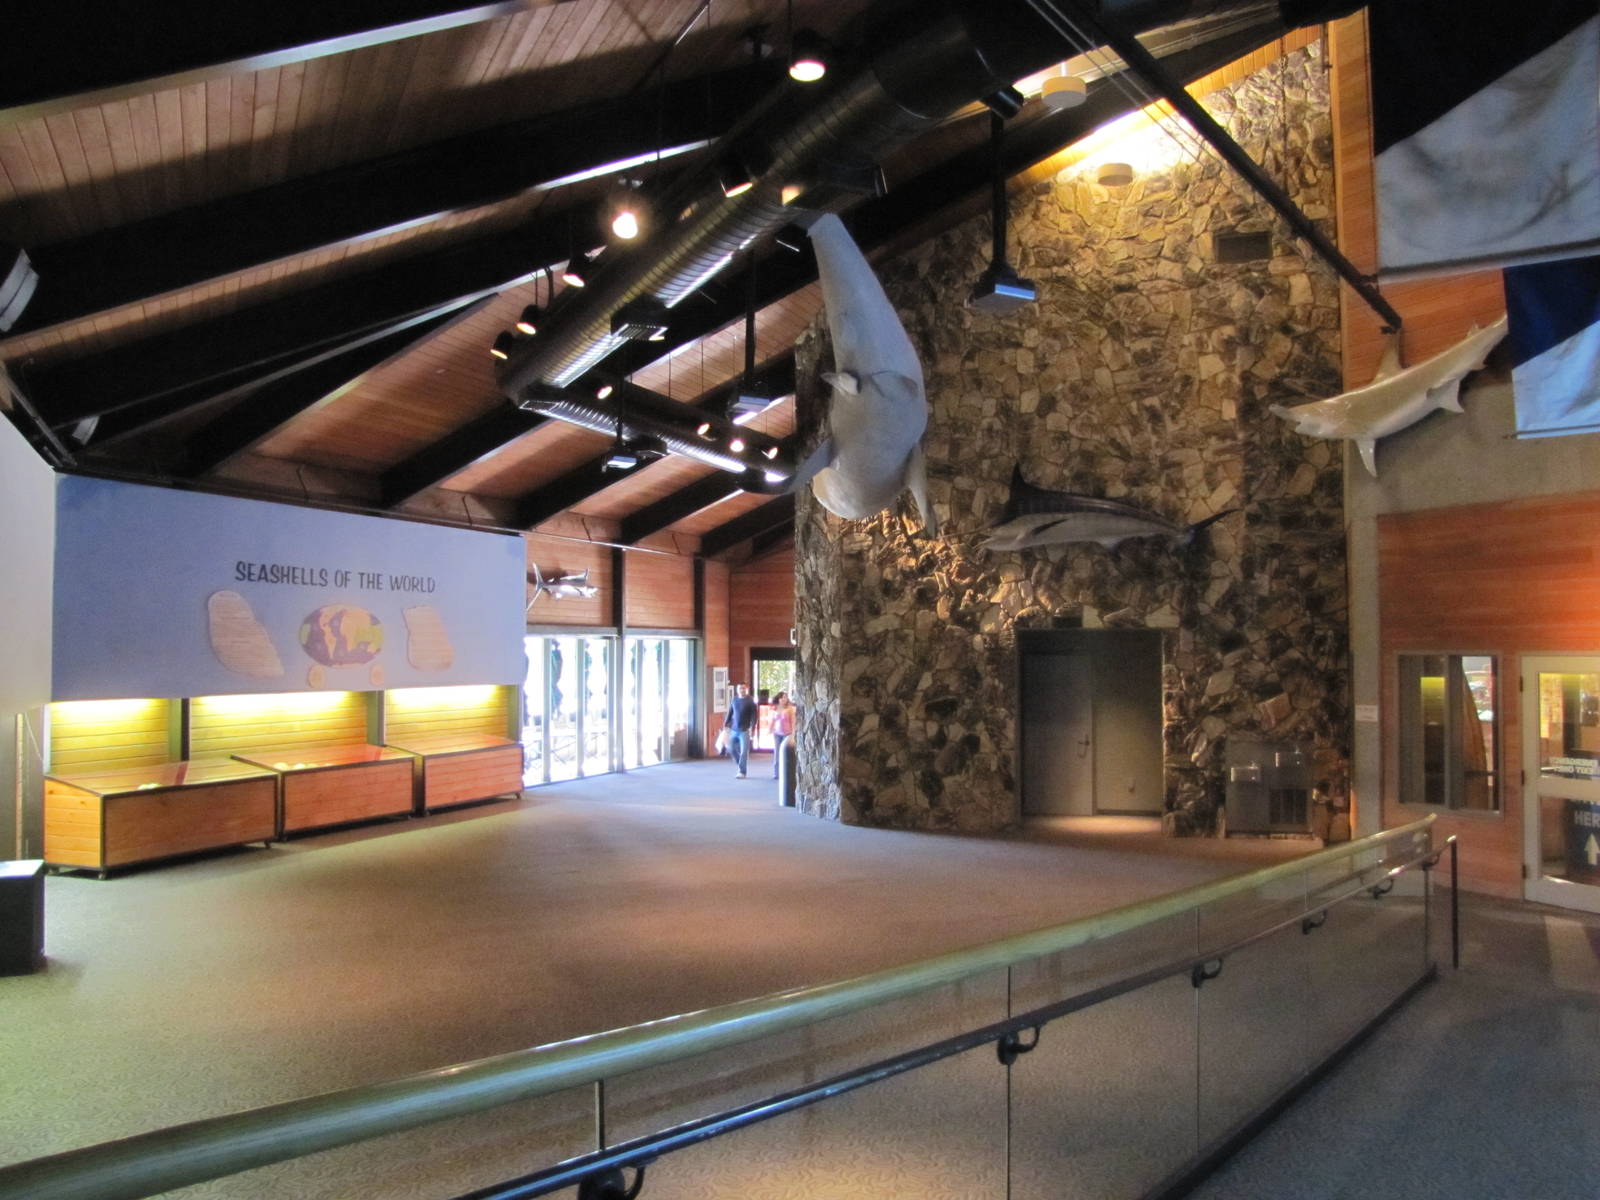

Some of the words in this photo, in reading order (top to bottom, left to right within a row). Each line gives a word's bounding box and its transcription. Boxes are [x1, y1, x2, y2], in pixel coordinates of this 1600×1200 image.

[235, 560, 328, 587] SEASHELLS
[334, 569, 352, 588] OF
[358, 571, 384, 591] THE
[389, 575, 435, 594] WORLD
